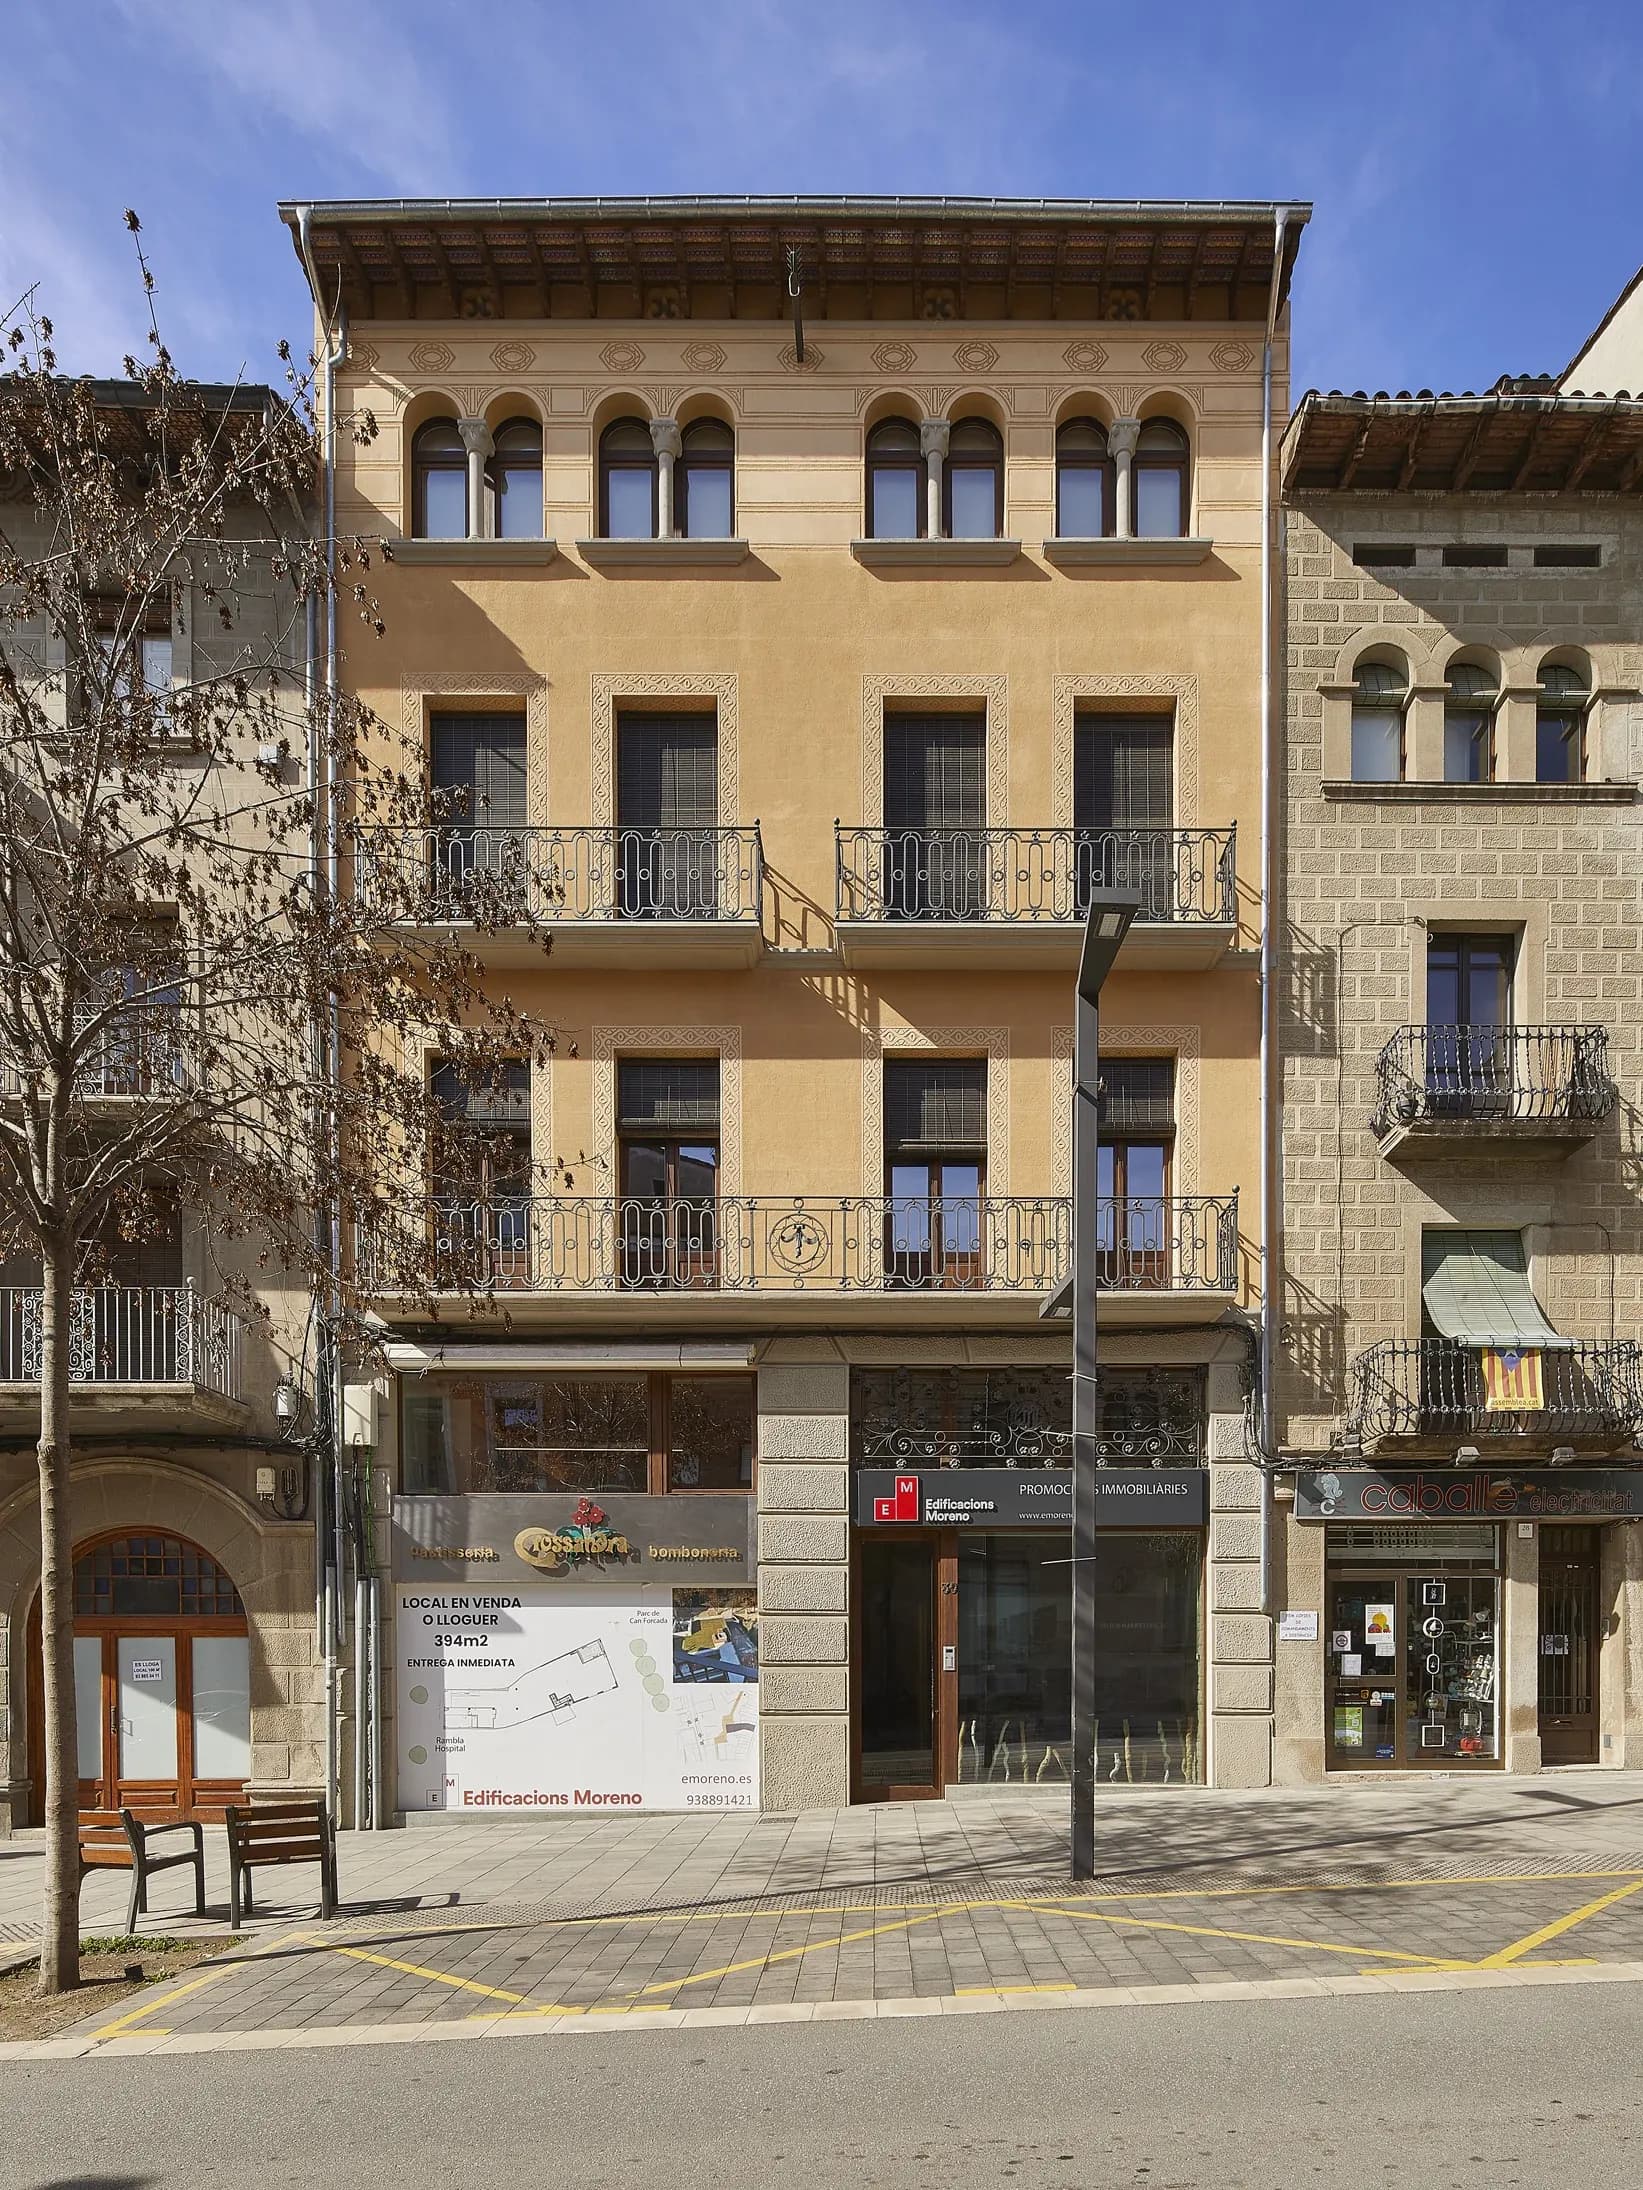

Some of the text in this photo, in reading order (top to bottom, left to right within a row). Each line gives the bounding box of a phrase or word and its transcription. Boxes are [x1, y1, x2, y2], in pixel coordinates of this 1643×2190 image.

[900, 1481, 913, 1493] M
[1101, 1482, 1188, 1495] IMMOBILIÀRIES
[881, 1504, 890, 1515] E
[925, 1498, 994, 1510] Edificacions
[925, 1510, 970, 1521] Moreno
[648, 1545, 739, 1558] bomboneria
[402, 1597, 522, 1609] LOCAL EN VENDA
[422, 1614, 499, 1626] O LLOGUER
[434, 1634, 489, 1647] 394m2
[407, 1658, 516, 1667] ENTREGA INMEDIATA
[436, 1736, 465, 1744] Rambla
[435, 1744, 466, 1753] Hospital
[445, 1779, 455, 1787] M
[681, 1775, 752, 1784] emoreno.es
[431, 1794, 438, 1802] E
[463, 1789, 643, 1806] Edificacions Moreno
[686, 1794, 753, 1806] 938891421
